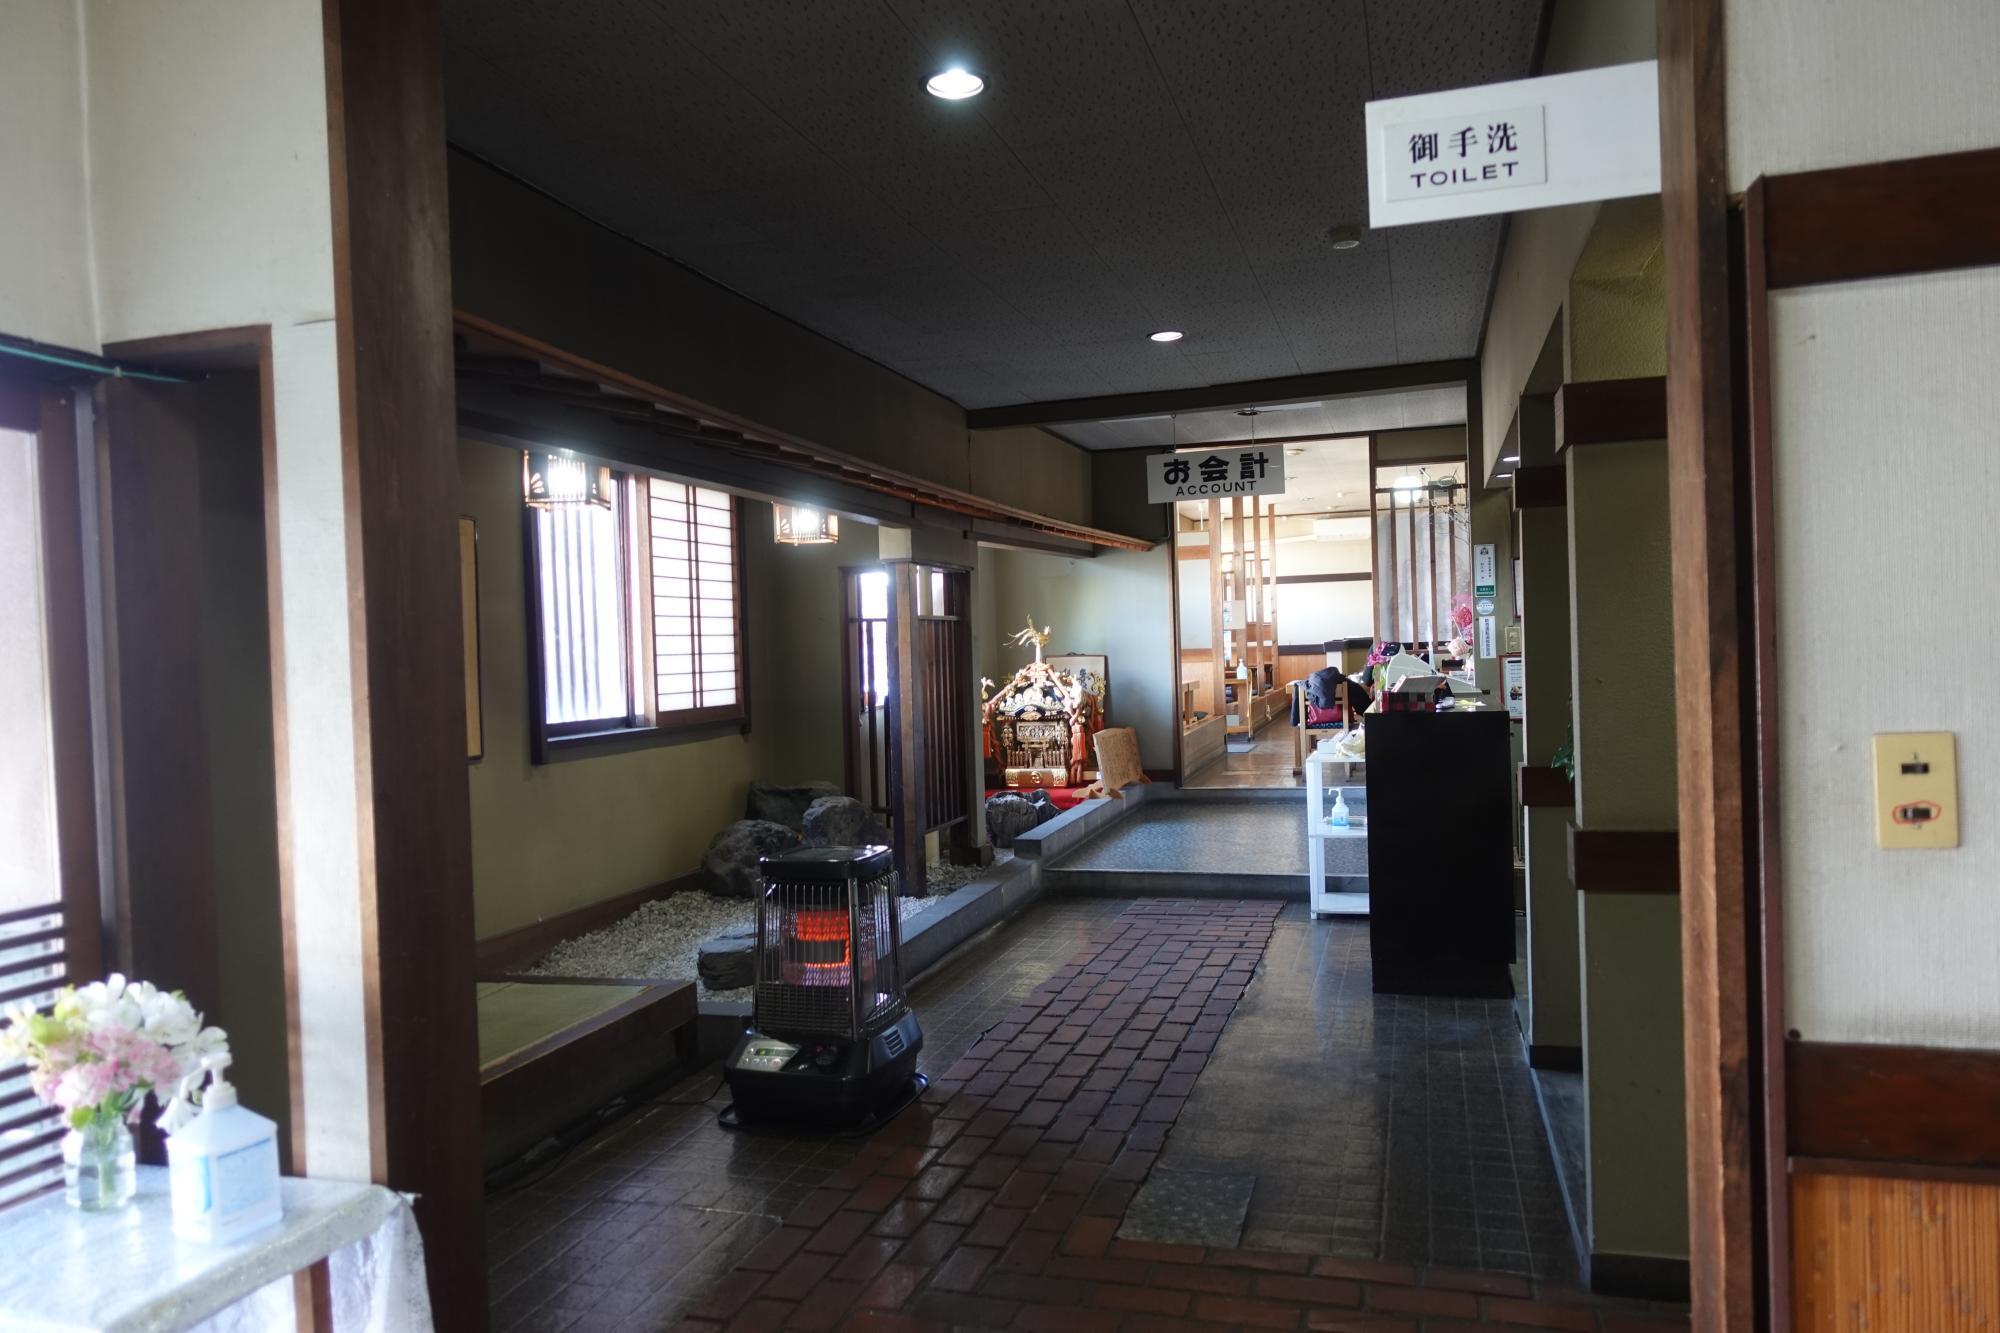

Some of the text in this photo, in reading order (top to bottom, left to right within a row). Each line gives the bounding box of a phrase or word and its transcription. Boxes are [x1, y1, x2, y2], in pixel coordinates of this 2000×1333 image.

[1409, 122, 1518, 163] 御手洗
[1411, 161, 1518, 188] TOILET
[1163, 452, 1268, 485] お会計
[1176, 480, 1256, 496] ACCOUNT
